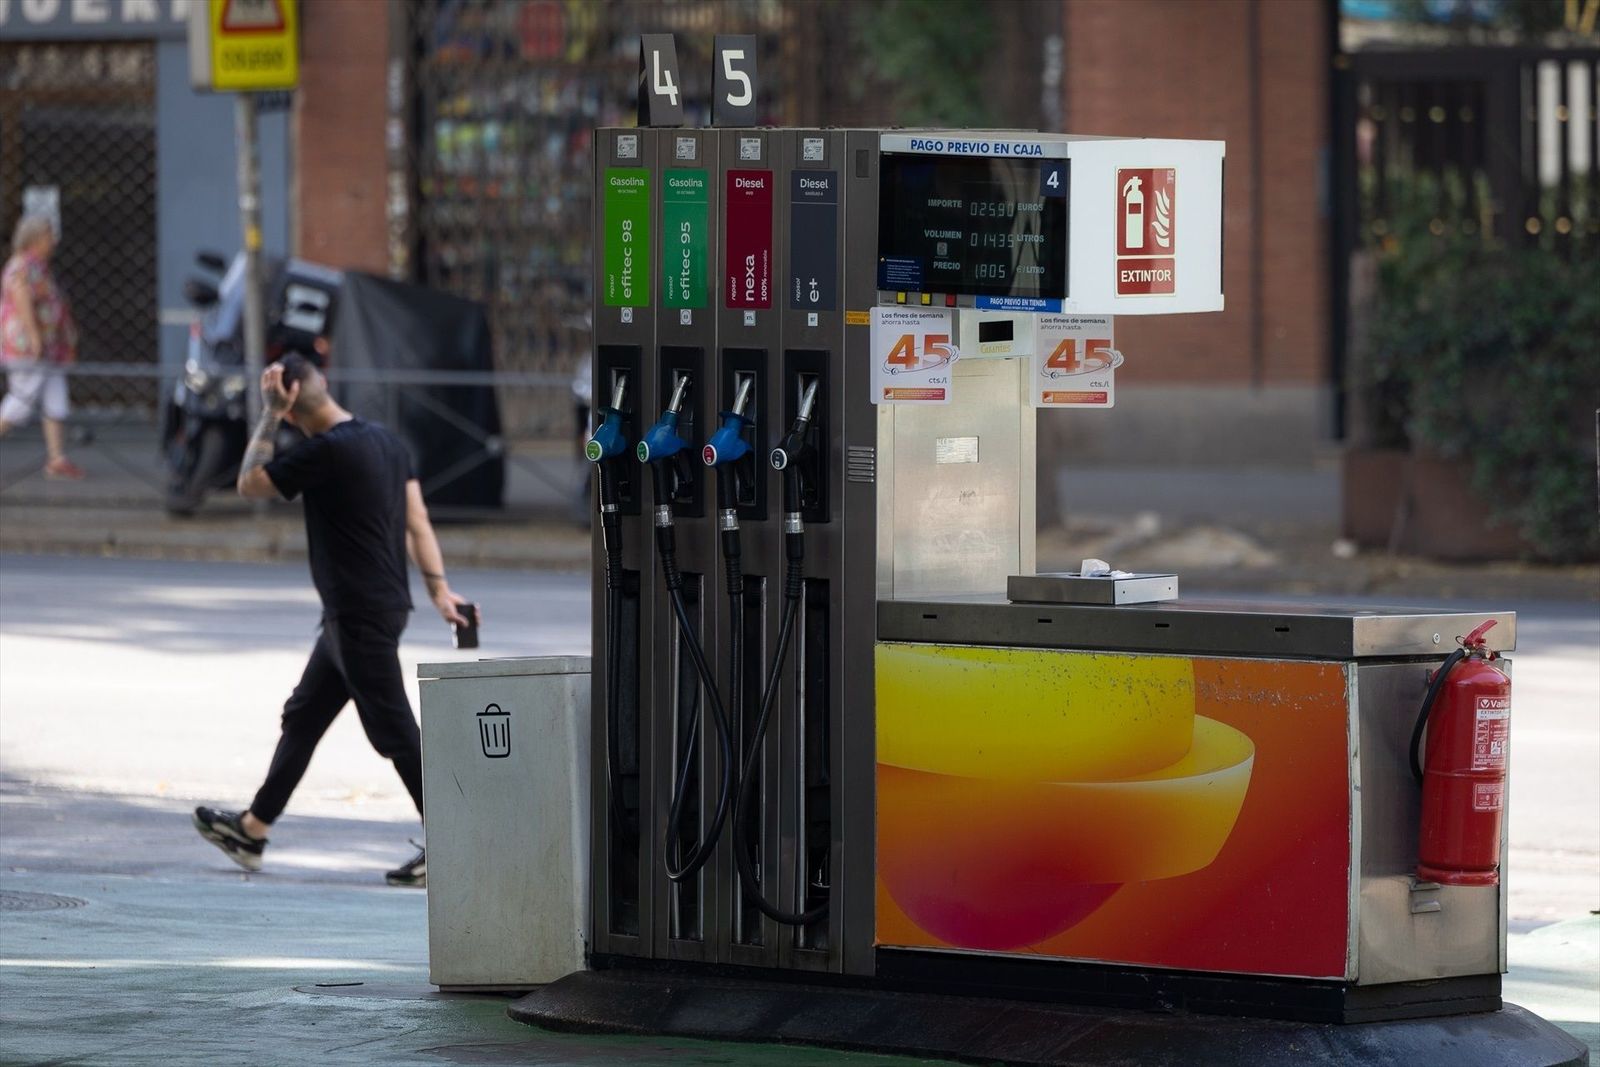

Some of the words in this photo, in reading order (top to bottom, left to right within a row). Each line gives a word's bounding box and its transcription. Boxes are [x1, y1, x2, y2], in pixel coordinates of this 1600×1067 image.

[653, 50, 678, 105] 4
[722, 50, 752, 106] 5
[911, 140, 943, 151] PAGO
[948, 141, 990, 154] PREVIO
[994, 143, 1009, 154] EN
[1013, 144, 1042, 156] CAJA
[610, 177, 645, 187] Gasolina
[669, 178, 703, 188] Gasolina
[735, 178, 764, 189] Diesel
[800, 178, 829, 189] Diesel
[1047, 171, 1059, 188] 4
[928, 199, 962, 208] IMPORTE
[1017, 203, 1044, 212] EUROS
[622, 219, 632, 242] 98
[680, 222, 690, 243] 95
[924, 229, 962, 239] VOLUMEN
[1016, 234, 1045, 243] LITROS
[621, 247, 632, 298] efitec
[933, 261, 961, 270] PRECIO
[681, 249, 690, 300] efitec
[745, 254, 755, 301] nexa
[1121, 269, 1171, 283] EXTINTOR
[809, 278, 820, 302] e+
[1004, 298, 1021, 306] PREVIO
[1029, 299, 1046, 307] TIENDA
[887, 334, 950, 369] 45
[1047, 339, 1113, 373] 45
